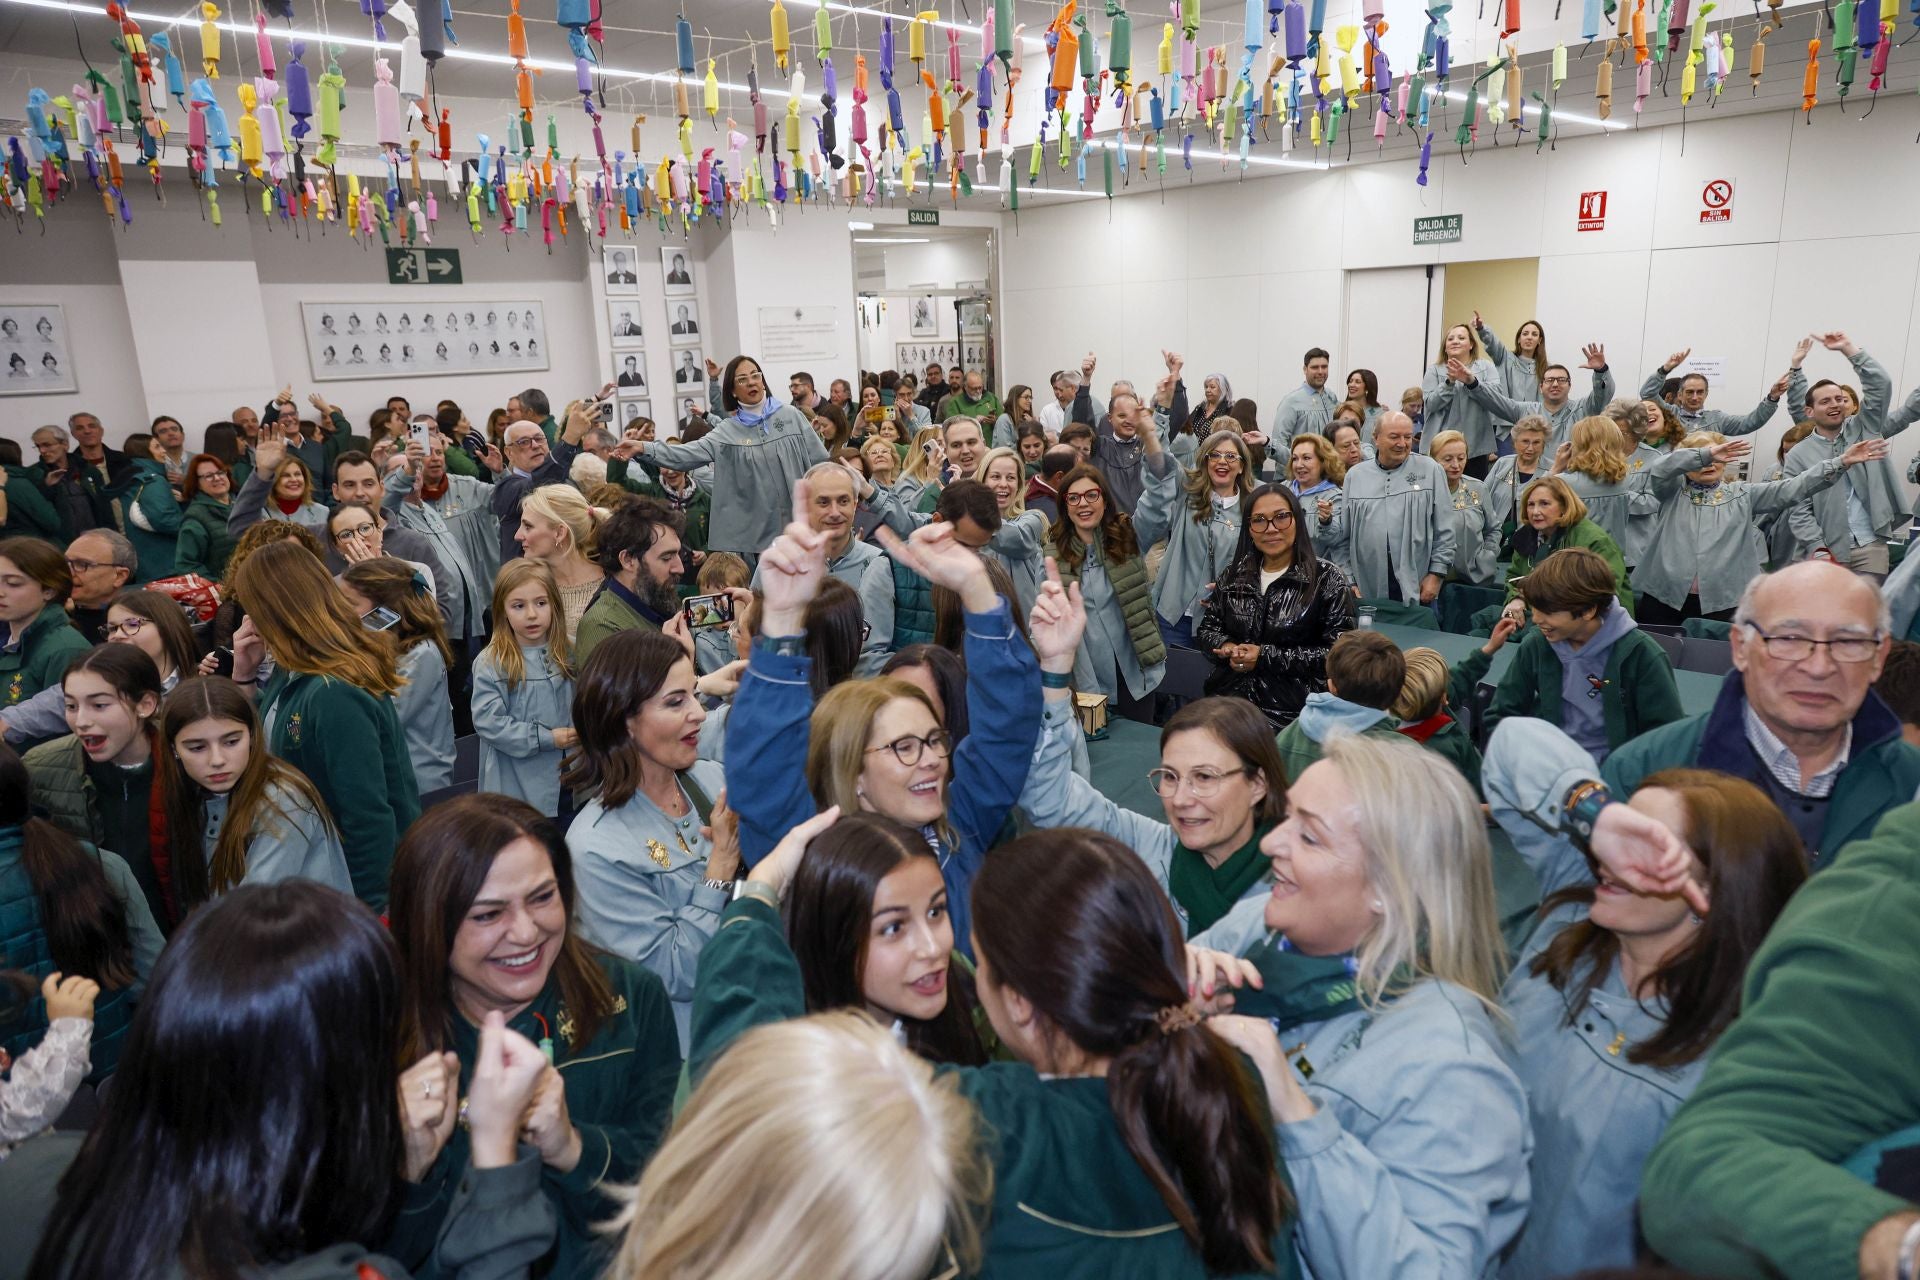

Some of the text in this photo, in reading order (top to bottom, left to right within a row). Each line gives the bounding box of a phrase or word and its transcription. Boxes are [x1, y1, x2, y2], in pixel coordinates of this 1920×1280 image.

[910, 212, 937, 223] SALIDA
[1418, 218, 1458, 230] SALIDA DE
[1414, 228, 1460, 242] EMERGENCIA
